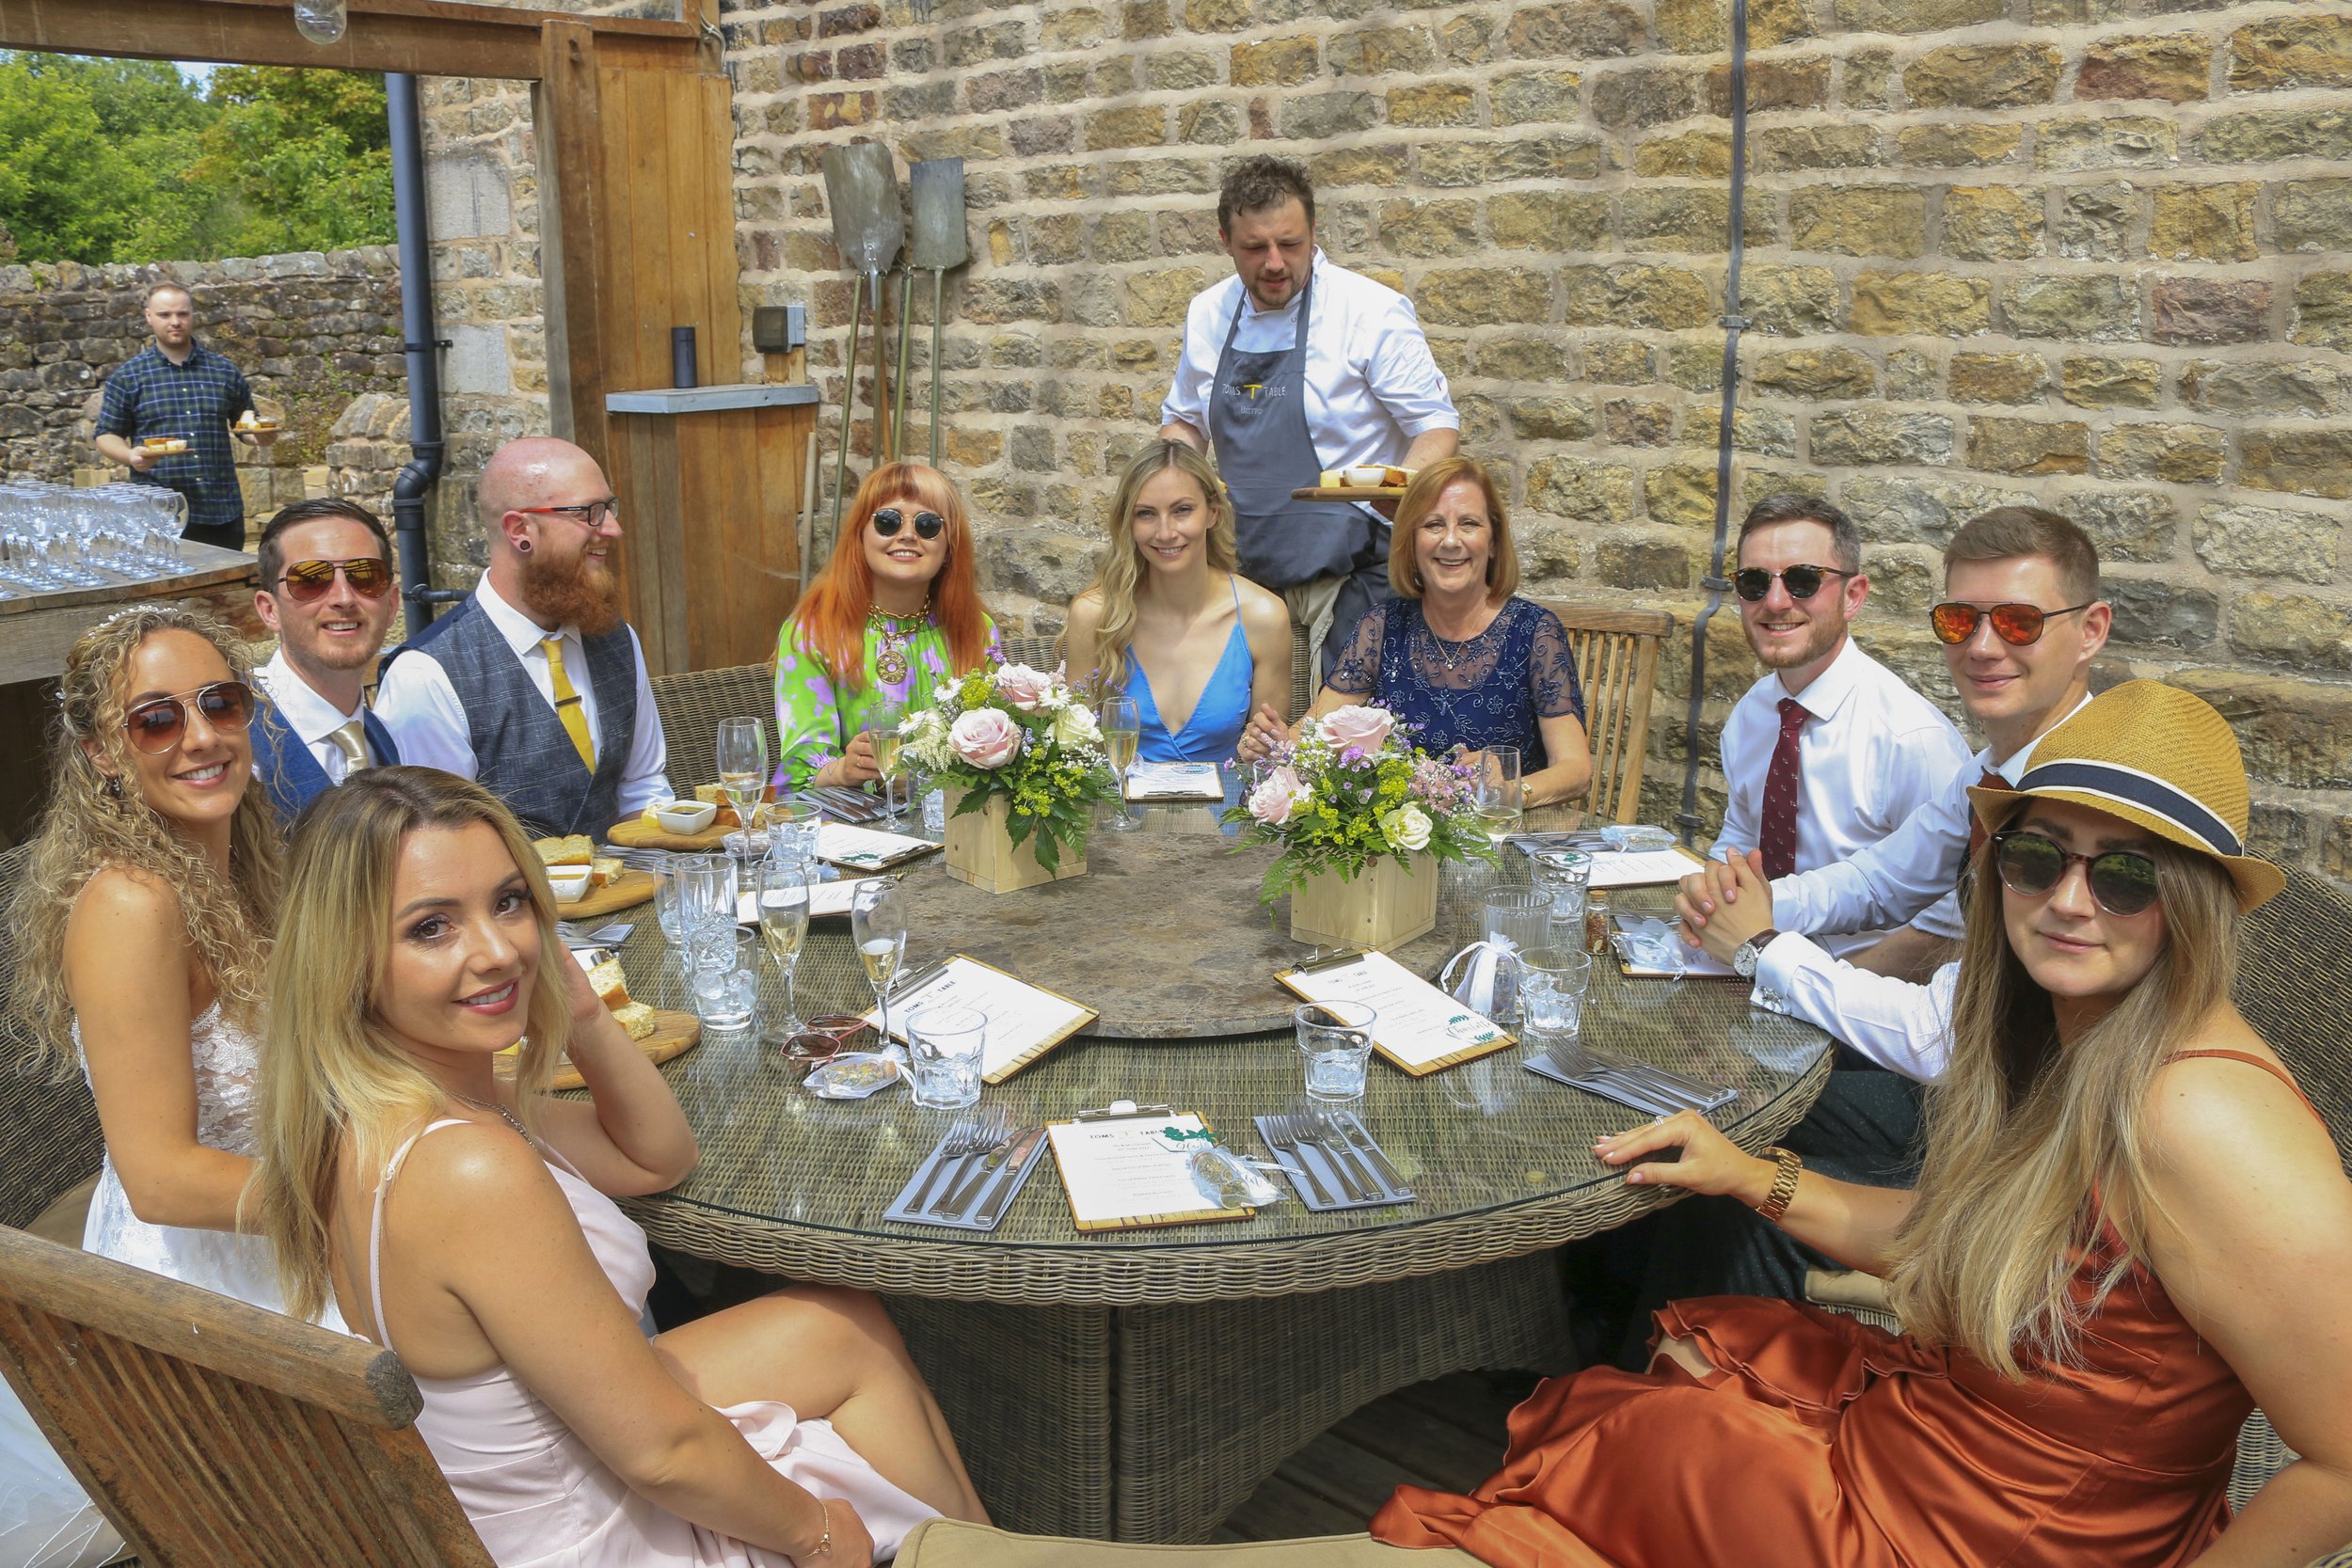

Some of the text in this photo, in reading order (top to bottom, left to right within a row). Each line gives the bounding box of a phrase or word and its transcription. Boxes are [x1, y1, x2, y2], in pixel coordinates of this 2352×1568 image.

[1222, 383, 1286, 400] TOMS T TABLE
[904, 1001, 924, 1013] TOMS
[937, 980, 957, 992] TABLE
